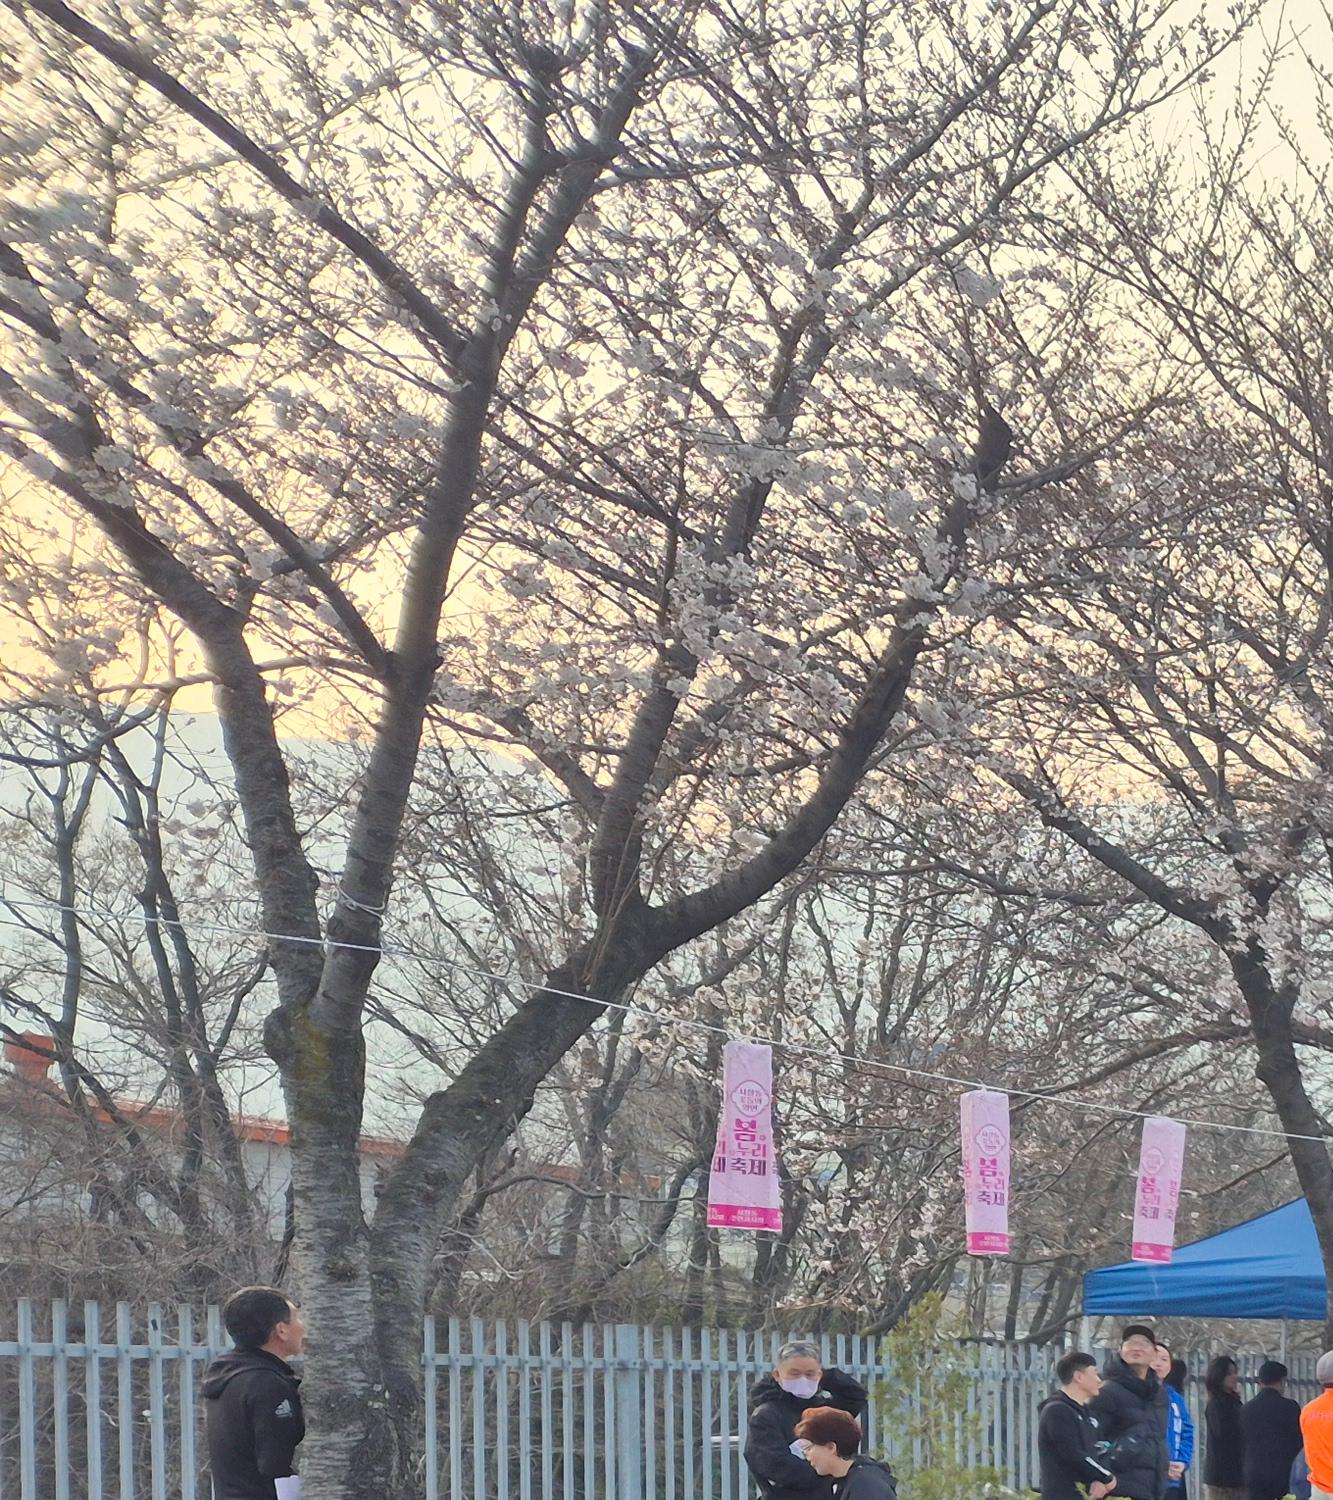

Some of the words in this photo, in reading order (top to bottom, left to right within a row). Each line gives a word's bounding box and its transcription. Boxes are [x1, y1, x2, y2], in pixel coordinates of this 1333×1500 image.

[733, 1118, 758, 1142] 봄
[737, 1142, 767, 1159] 누리
[730, 1157, 767, 1176] 축제
[978, 1157, 998, 1177] 봄
[977, 1190, 1005, 1206] 축제
